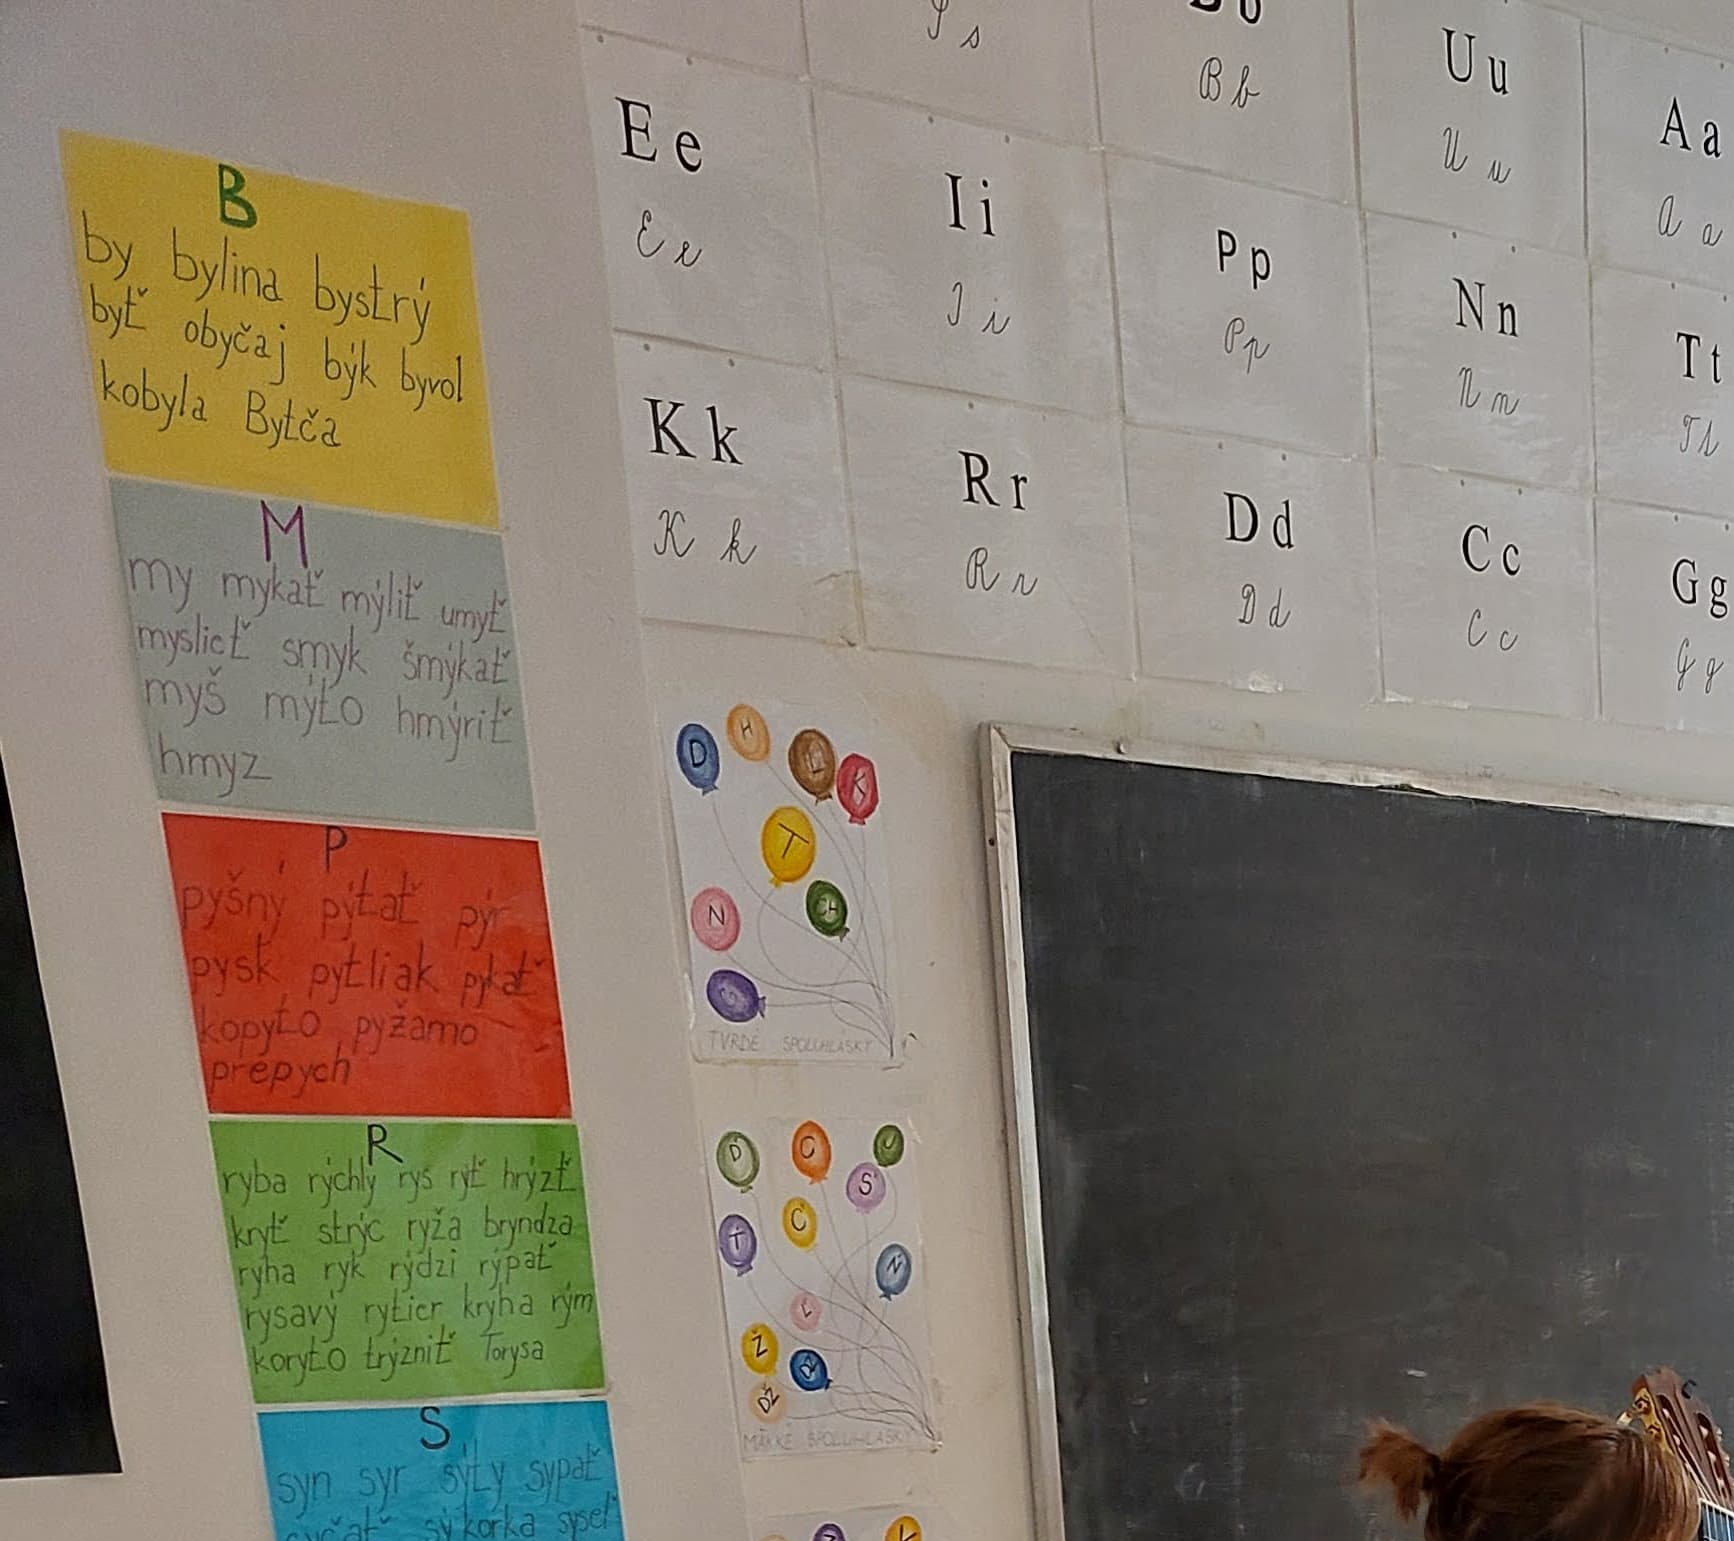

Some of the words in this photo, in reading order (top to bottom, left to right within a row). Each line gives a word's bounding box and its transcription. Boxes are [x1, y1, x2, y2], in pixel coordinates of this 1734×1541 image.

[217, 162, 258, 229] B
[82, 210, 134, 281] by
[172, 226, 284, 303] bylina
[314, 253, 431, 345] bystrý
[89, 284, 148, 339] byť
[184, 308, 286, 386] obyčaj
[325, 336, 377, 401] býk
[401, 348, 463, 412] byvol
[101, 359, 208, 432] kobyla
[245, 390, 342, 449] Bytča
[260, 500, 308, 569] M
[128, 557, 192, 614] my
[222, 562, 325, 617] mykať
[341, 570, 424, 633] mýliť
[441, 589, 507, 644] umyť
[137, 614, 252, 667] myslieť
[282, 625, 368, 690] smyk
[403, 639, 511, 700] šmýkať
[144, 665, 227, 727] myš
[397, 694, 513, 764] hmýriť
[741, 719, 753, 738] H
[158, 732, 272, 798] hmyz
[689, 739, 707, 768] D
[323, 825, 349, 872] P
[778, 823, 809, 858] T
[180, 860, 287, 931] pyšný
[321, 867, 424, 941] pýtať
[708, 904, 725, 926] N
[189, 932, 280, 997] pysk
[309, 938, 439, 1005] pytliak
[200, 993, 321, 1058] kopyto
[352, 1001, 478, 1056] pyžamo
[208, 1041, 352, 1099] prepych
[366, 1123, 403, 1166] R
[800, 1135, 815, 1159] C
[223, 1158, 288, 1207] ryba
[502, 1151, 577, 1201] hrýzť
[230, 1212, 289, 1260] kryť
[318, 1210, 386, 1259] strýc
[407, 1206, 462, 1258] ryža
[483, 1202, 574, 1252] bryndza
[238, 1252, 296, 1299] ryha
[323, 1250, 366, 1294] ryk
[389, 1249, 457, 1292] rýdzi
[479, 1241, 557, 1291] rýpať
[364, 1295, 442, 1337] rytier
[463, 1282, 534, 1328] kryha
[551, 1282, 596, 1329] rým
[252, 1336, 347, 1387] koryto
[364, 1325, 457, 1382] trýzniť
[480, 1331, 545, 1379] Torysa
[419, 1405, 450, 1450] S
[277, 1468, 331, 1519] syn
[359, 1462, 406, 1513] syr
[524, 1441, 601, 1506] sypať
